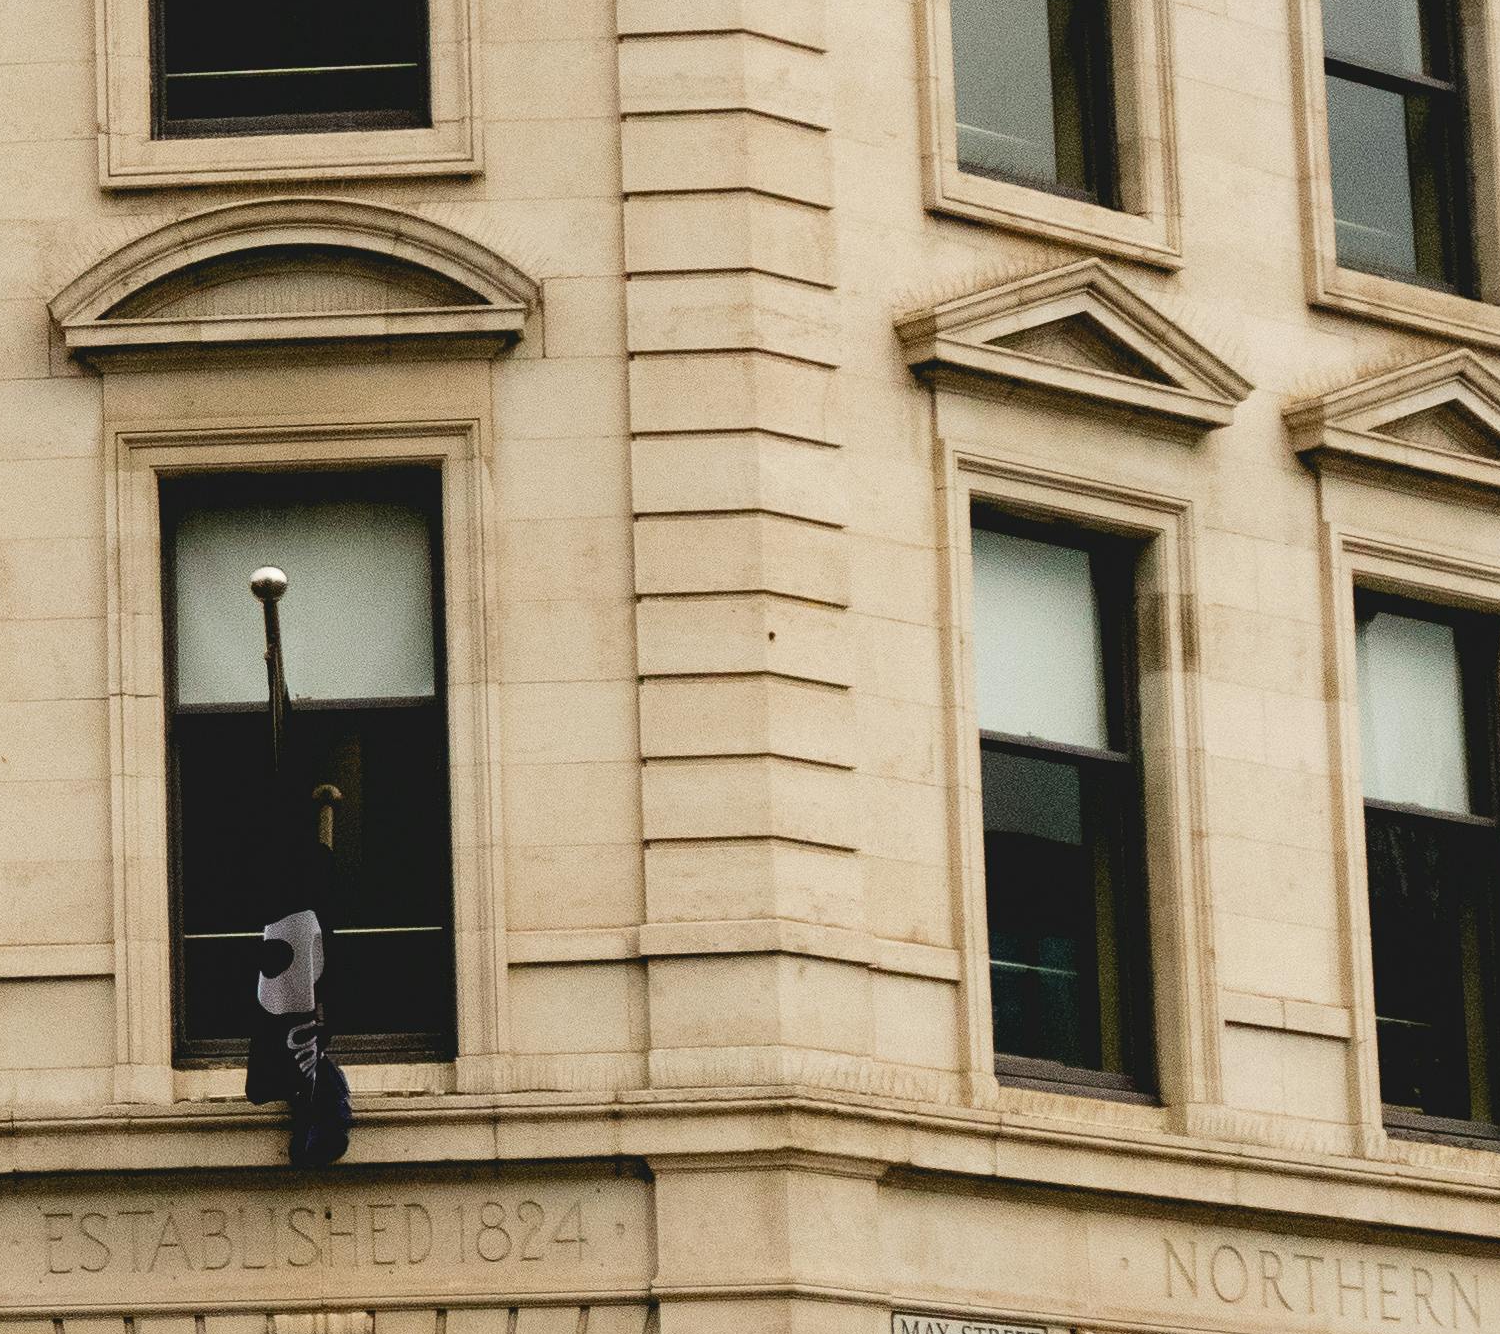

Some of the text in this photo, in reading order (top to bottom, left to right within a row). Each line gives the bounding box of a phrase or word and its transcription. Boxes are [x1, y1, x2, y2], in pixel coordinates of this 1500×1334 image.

[42, 1199, 589, 1275] ESTABLISHED 1824
[1160, 1236, 1482, 1330] NORTHERN
